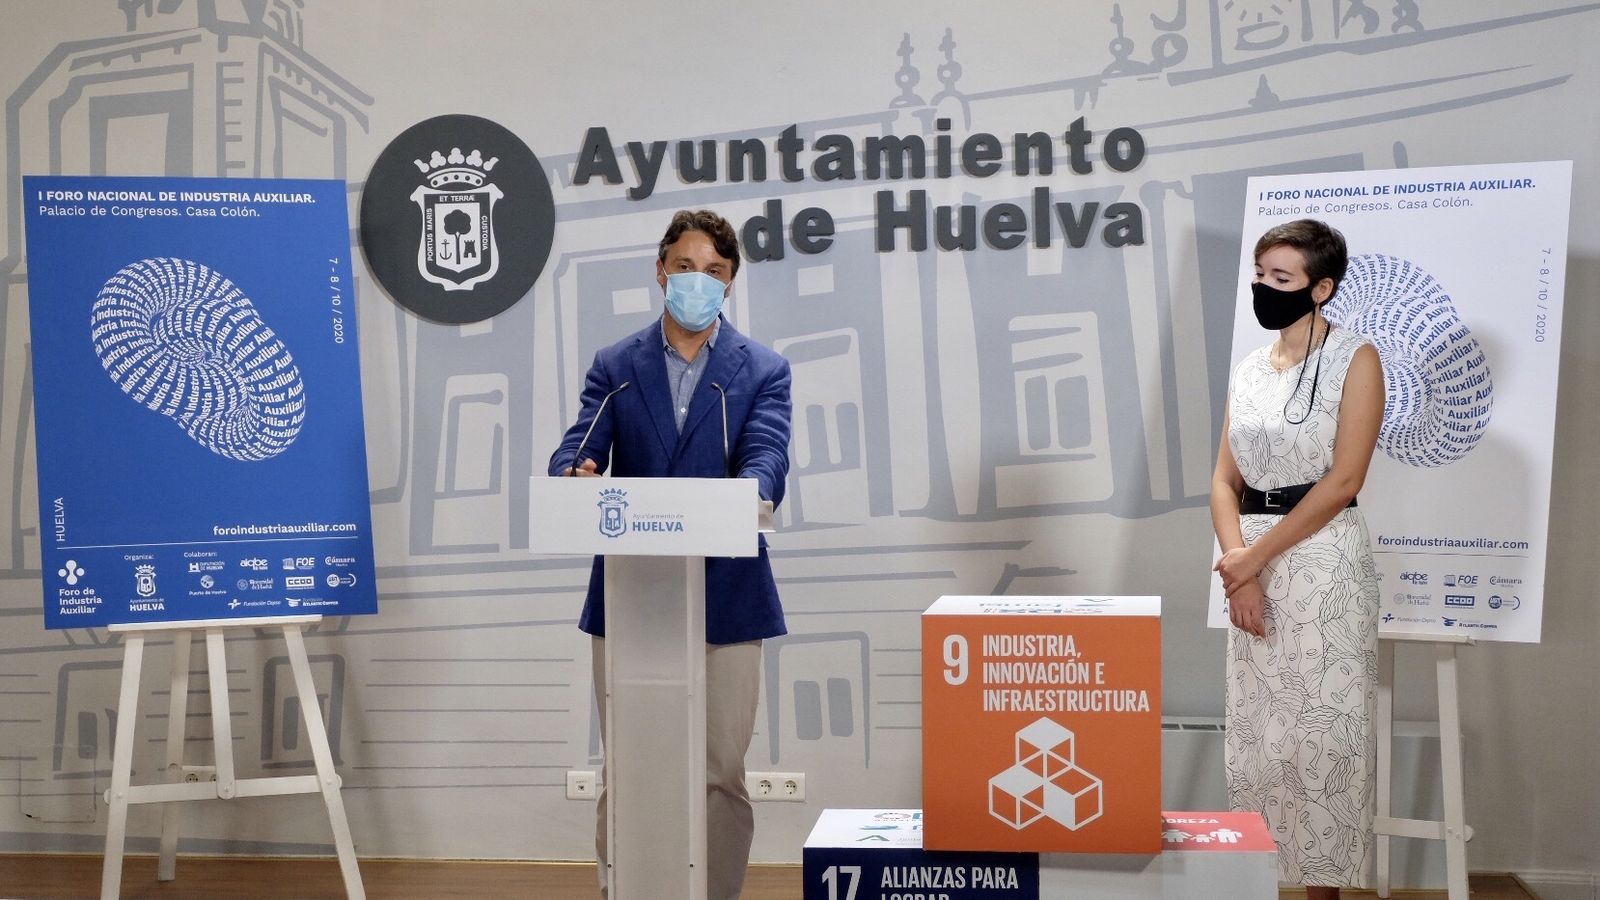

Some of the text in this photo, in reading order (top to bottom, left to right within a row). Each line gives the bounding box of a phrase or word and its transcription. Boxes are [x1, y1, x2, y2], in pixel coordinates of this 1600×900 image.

[573, 116, 1146, 200] Ayuntamiento
[46, 191, 84, 201] FORO
[87, 191, 156, 201] NACIONAL
[159, 191, 177, 202] DE
[180, 192, 250, 202] INDUSTRIA
[253, 192, 316, 203] AUXILIAR.
[1267, 190, 1300, 201] FORO
[1304, 186, 1369, 199] NACIONAL
[1373, 185, 1390, 196] DE
[1394, 182, 1465, 195] INDUSTRIA
[1469, 178, 1536, 191] AUXILIAR.
[39, 205, 260, 218] Palacio de Congresos. Casa Colón.
[1258, 196, 1473, 216] Palacio de Congresos. Casa Colón.
[740, 186, 1145, 262] de Huelva
[331, 294, 341, 306] 10
[1538, 288, 1548, 301] 10
[333, 317, 344, 344] 2020
[1535, 314, 1546, 343] 2020
[54, 497, 65, 542] HUELVA
[632, 521, 684, 532] HUELVA
[213, 522, 356, 536] foroindustriaauxiliar.com
[1378, 535, 1529, 550] foroindustriaauxiliar.com
[296, 557, 315, 566] FOE
[1457, 575, 1479, 585] FOE
[59, 587, 95, 597] Foro de
[59, 596, 102, 605] Industria
[60, 606, 96, 615] Auxiliar
[130, 603, 164, 611] HUELVA
[982, 635, 1082, 658] INDUSTRIA,
[943, 634, 969, 685] 9
[982, 659, 1105, 685] INNOVACIÓN E
[983, 689, 1151, 712] INFRAESTRUCTURA
[821, 865, 862, 900] 17
[881, 867, 1019, 889] ALIANZAS PARA
